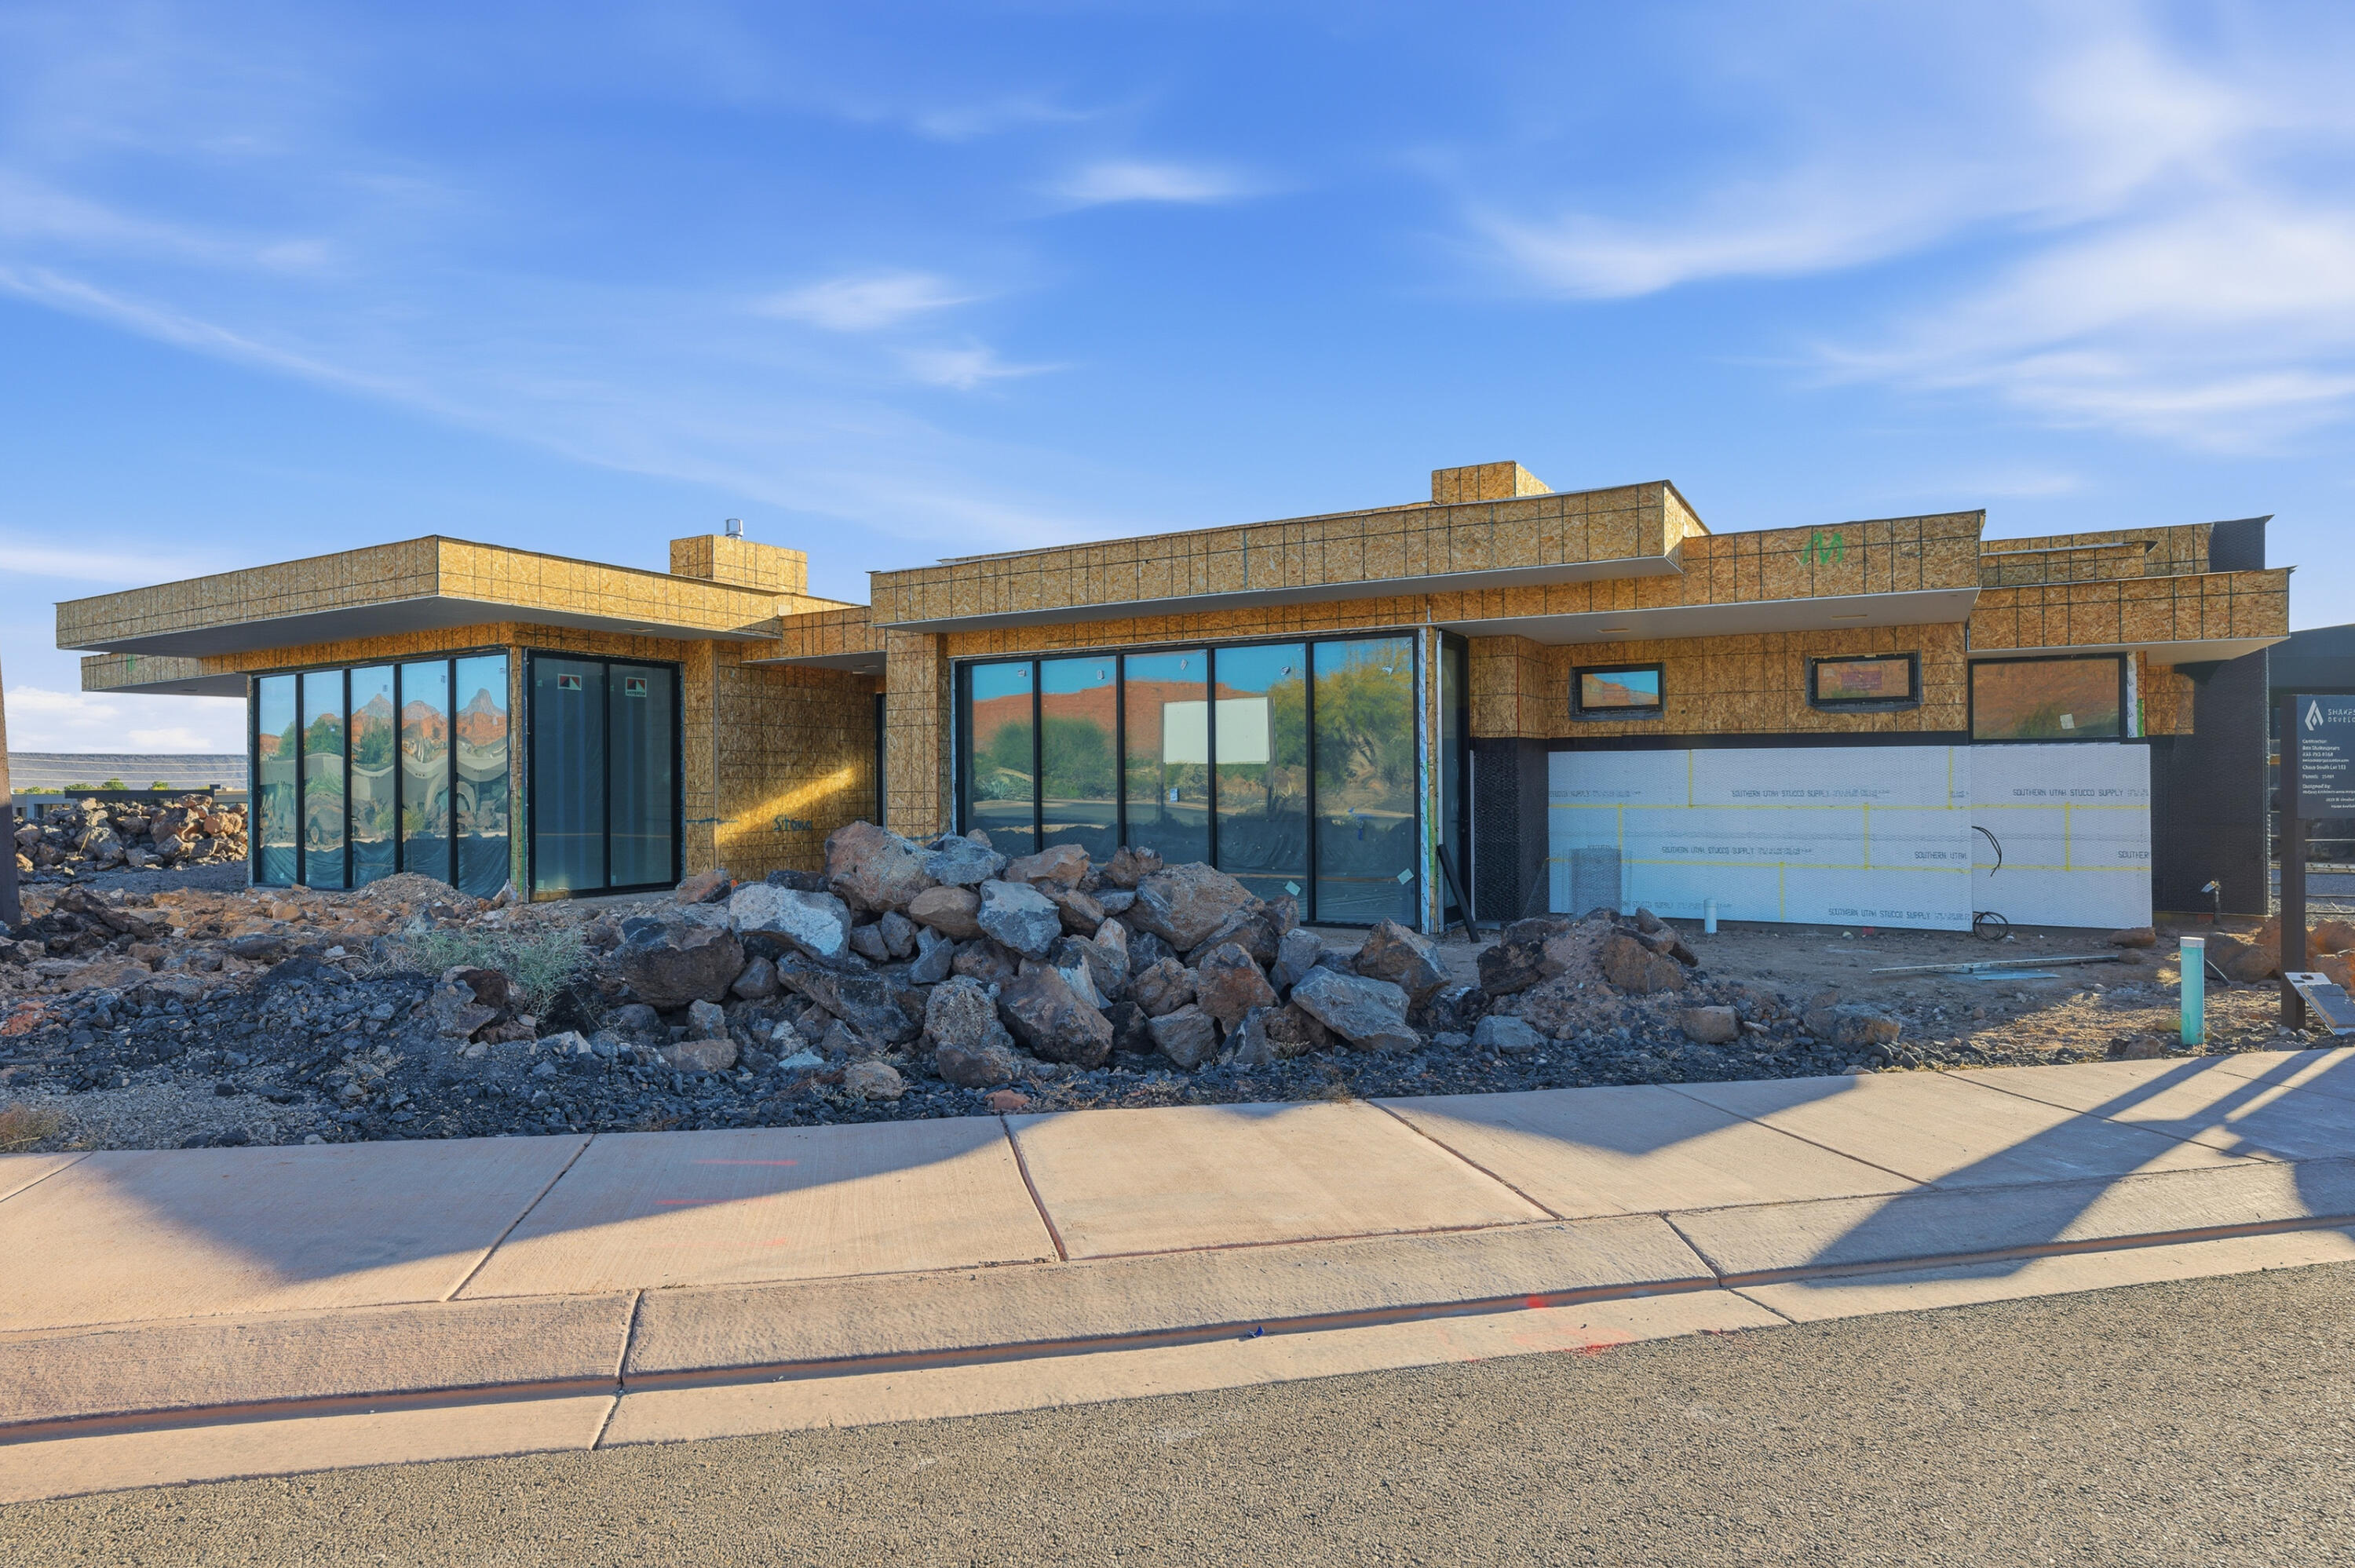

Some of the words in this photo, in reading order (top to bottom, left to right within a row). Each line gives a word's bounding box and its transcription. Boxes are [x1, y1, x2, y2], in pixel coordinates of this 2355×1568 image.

[1828, 908, 1858, 917] SOUTHERN
[1861, 909, 1877, 917] UTAH
[1880, 910, 1904, 918] STUCCO
[1906, 911, 1930, 920] SUPPLY
